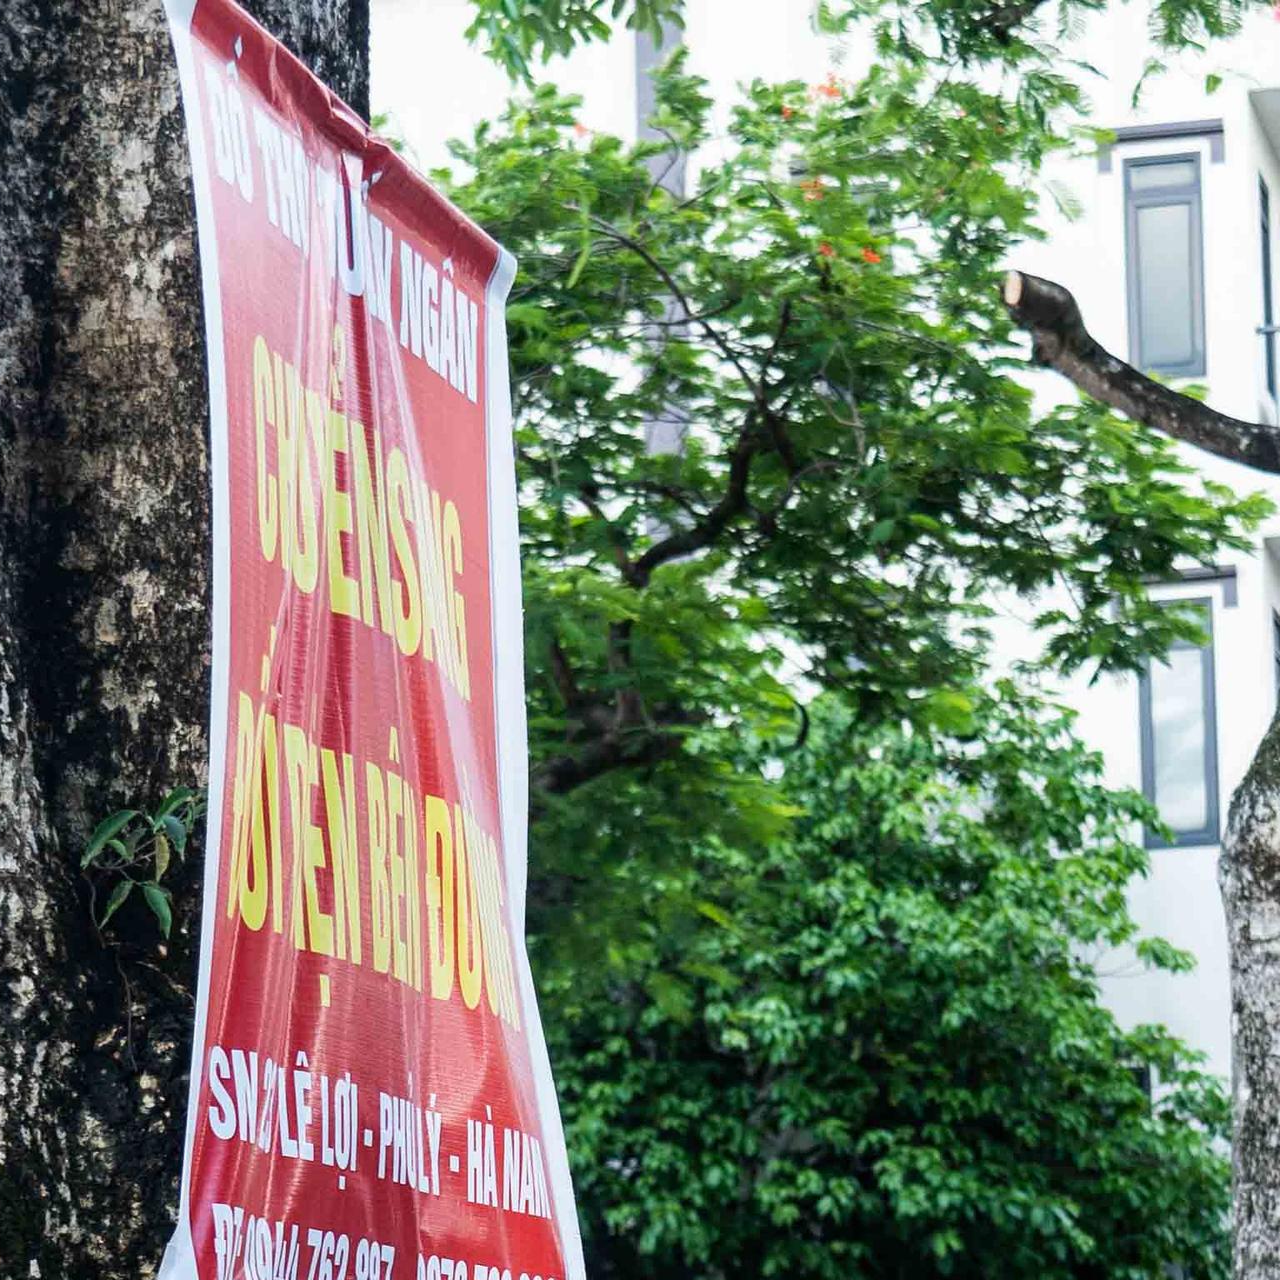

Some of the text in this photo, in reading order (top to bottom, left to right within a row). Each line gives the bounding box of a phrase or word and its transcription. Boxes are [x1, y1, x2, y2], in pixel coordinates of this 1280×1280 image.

[399, 239, 478, 405] NGÂN
[366, 725, 422, 993] BÊN
[208, 1045, 258, 1144] SN
[278, 1050, 315, 1162] LÊ
[321, 1071, 358, 1190] LỢI
[467, 1105, 498, 1207] HÀ
[503, 1128, 552, 1220] NAM
